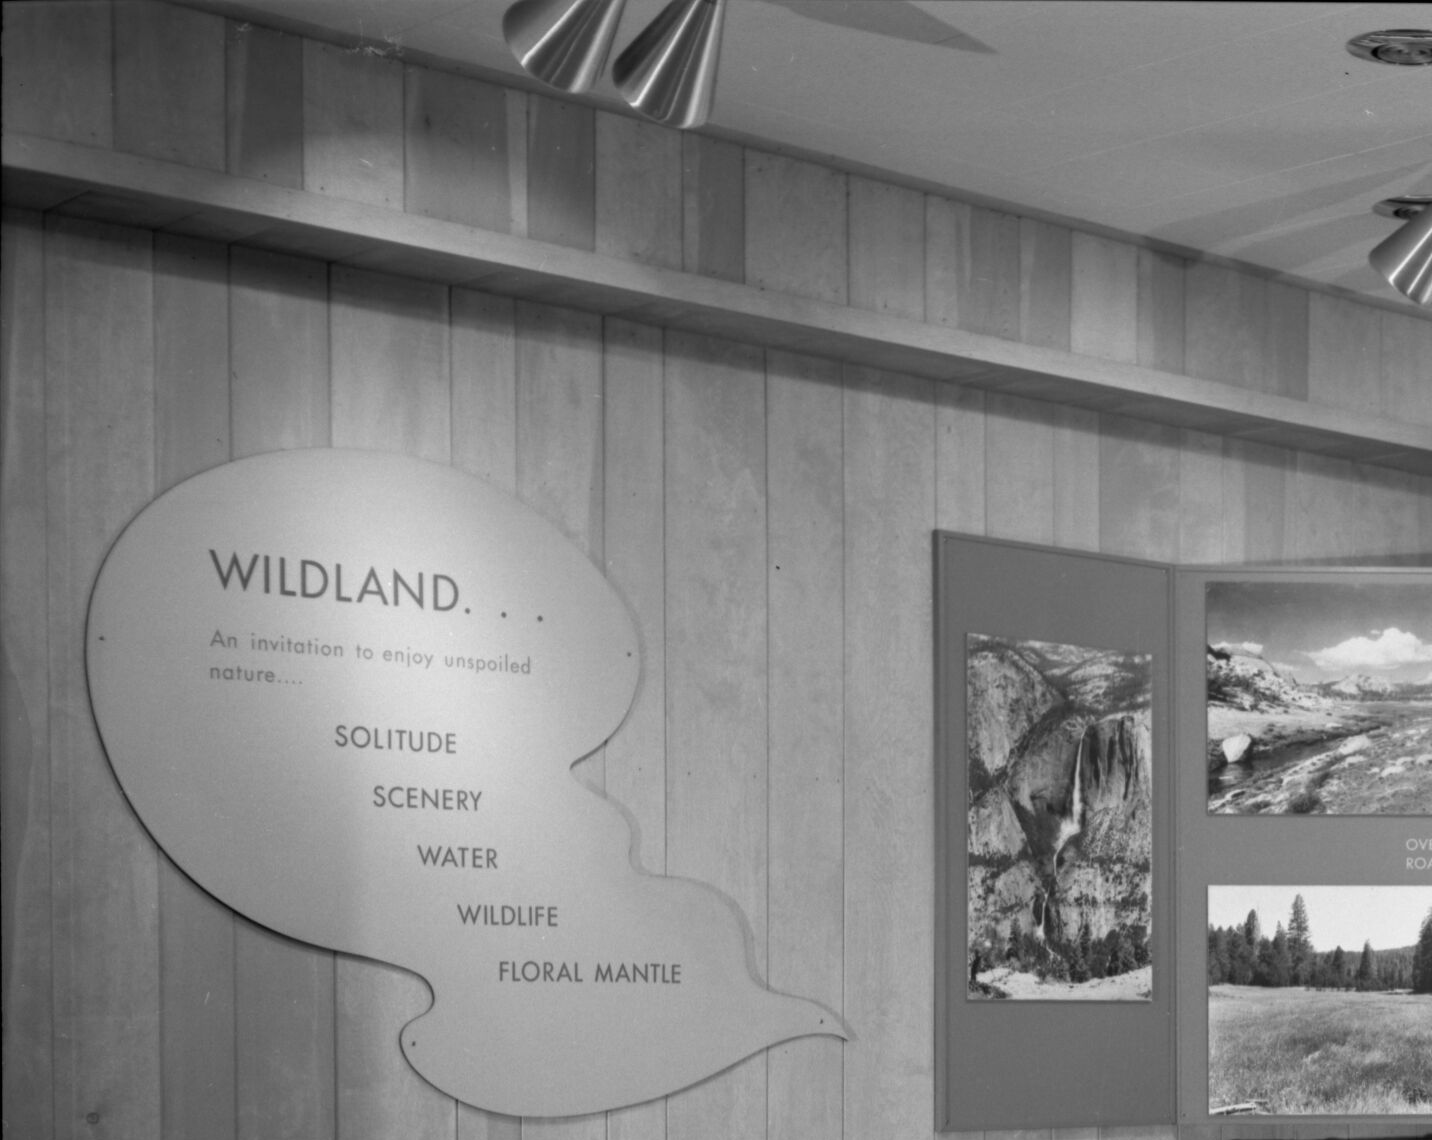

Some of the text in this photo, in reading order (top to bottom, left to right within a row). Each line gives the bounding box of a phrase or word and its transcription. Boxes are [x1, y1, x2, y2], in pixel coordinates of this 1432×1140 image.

[209, 629, 531, 675] An invitation to enjoy unspoiled
[334, 724, 457, 755] SOLITUDE
[373, 785, 483, 812] SCENERY
[416, 844, 498, 870] WATER
[456, 903, 558, 928] WILDLIFE
[498, 960, 681, 985] FLORAL MANTLE
